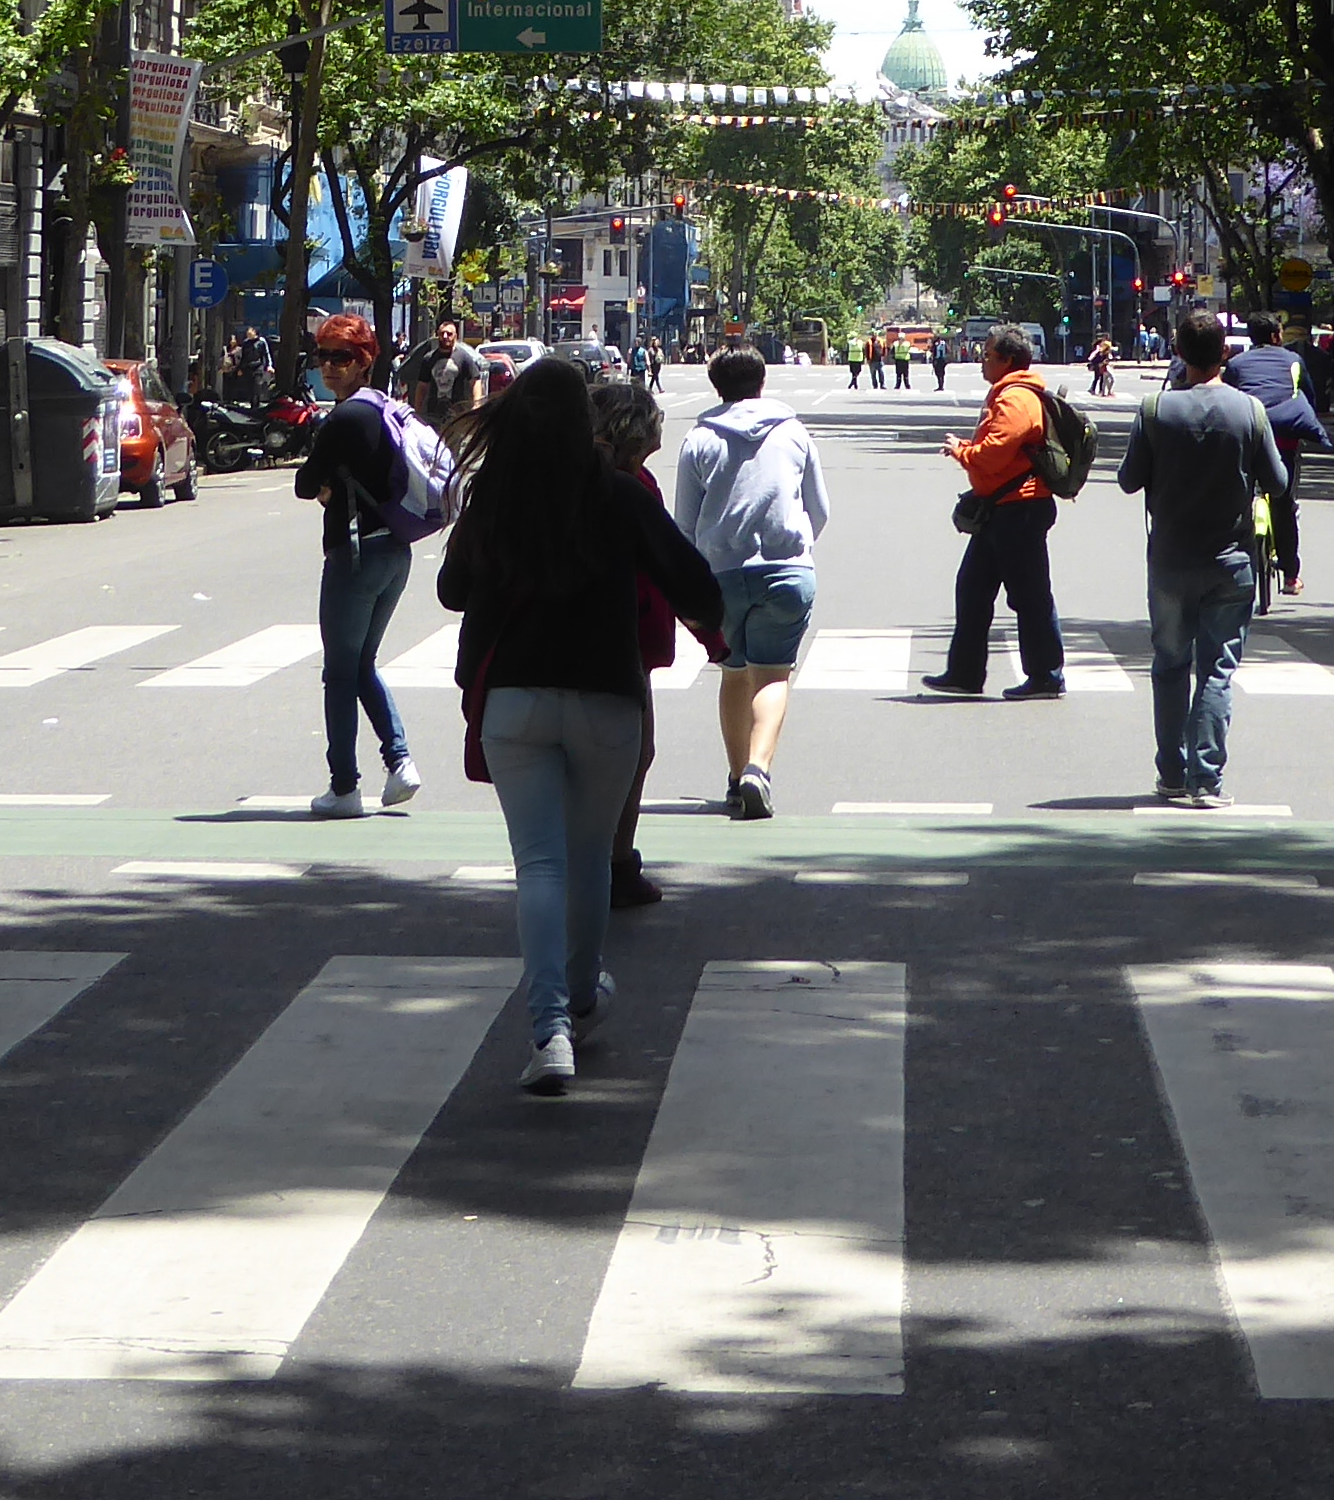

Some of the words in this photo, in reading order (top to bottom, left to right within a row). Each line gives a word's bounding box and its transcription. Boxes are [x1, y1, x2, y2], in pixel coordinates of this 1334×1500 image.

[468, 1, 592, 18] Internacional
[391, 35, 452, 51] Ezeiza
[195, 262, 213, 288] E
